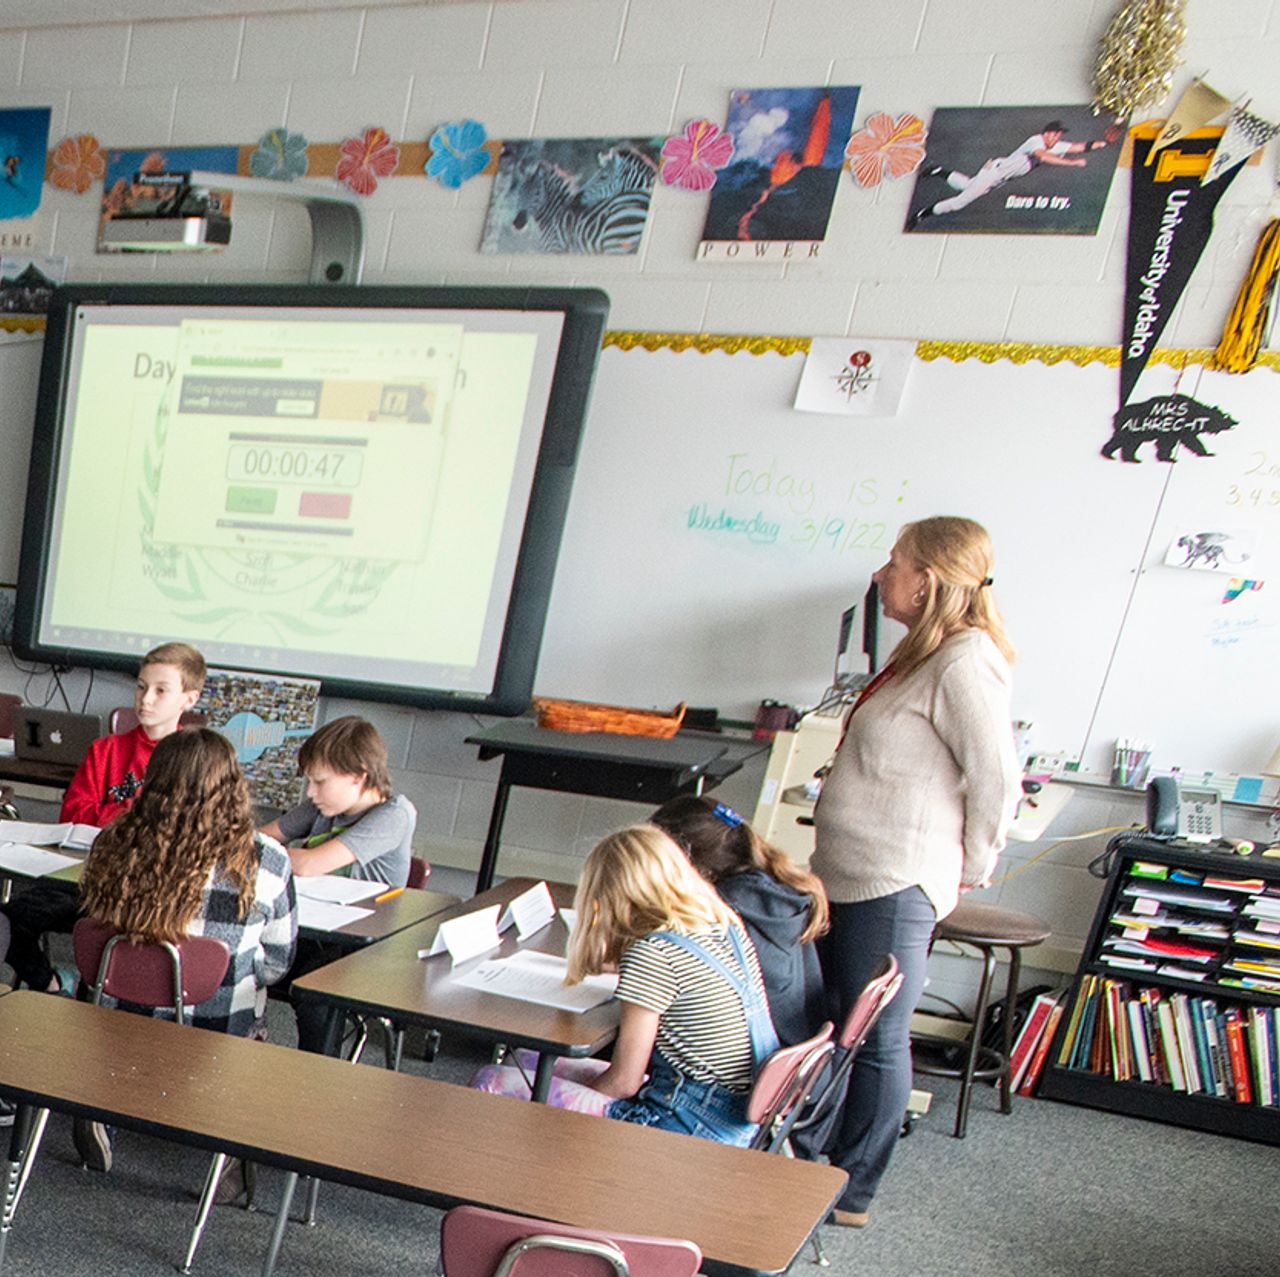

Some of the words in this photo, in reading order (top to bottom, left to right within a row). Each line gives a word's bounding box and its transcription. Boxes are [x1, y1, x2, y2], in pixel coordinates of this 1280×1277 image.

[1005, 194, 1036, 209] Dare
[1037, 196, 1048, 209] to
[1049, 197, 1071, 213] try.
[701, 241, 823, 258] POWER
[1141, 189, 1190, 288] University
[1127, 299, 1162, 359] Idaho
[133, 353, 178, 386] Day
[1150, 401, 1189, 416] MRS
[244, 448, 345, 480] 00:00:47
[725, 452, 817, 515] Today
[686, 502, 782, 545] Wednesday
[790, 511, 888, 555] 3/9/22
